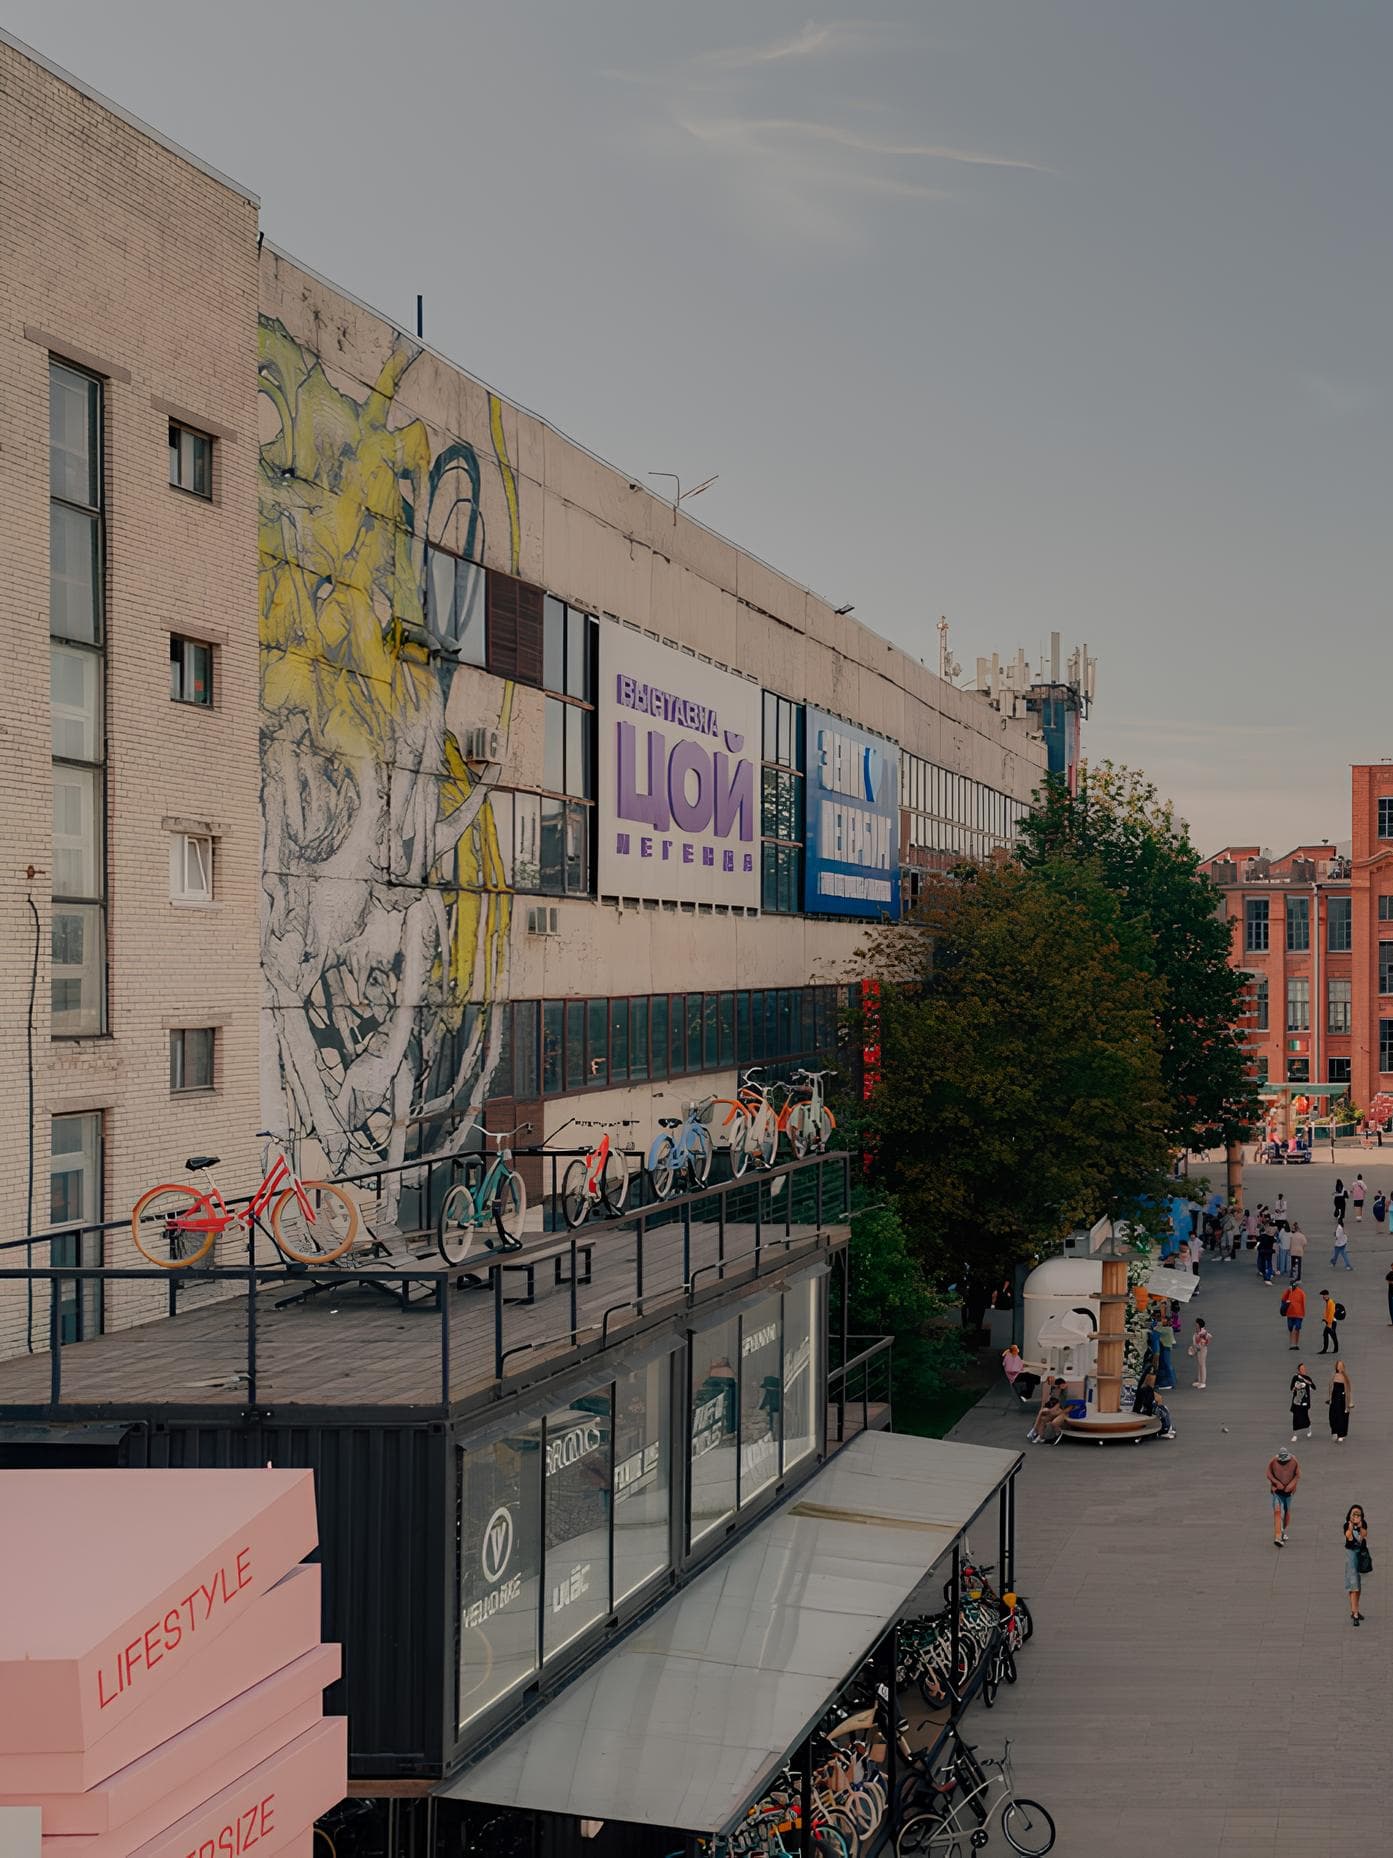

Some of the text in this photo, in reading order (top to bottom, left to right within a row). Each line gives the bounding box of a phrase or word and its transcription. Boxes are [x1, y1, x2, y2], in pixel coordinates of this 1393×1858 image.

[617, 721, 754, 842] ЦОЙ
[98, 1547, 253, 1709] LIFESTYLE
[186, 1794, 275, 1858] SIZE
